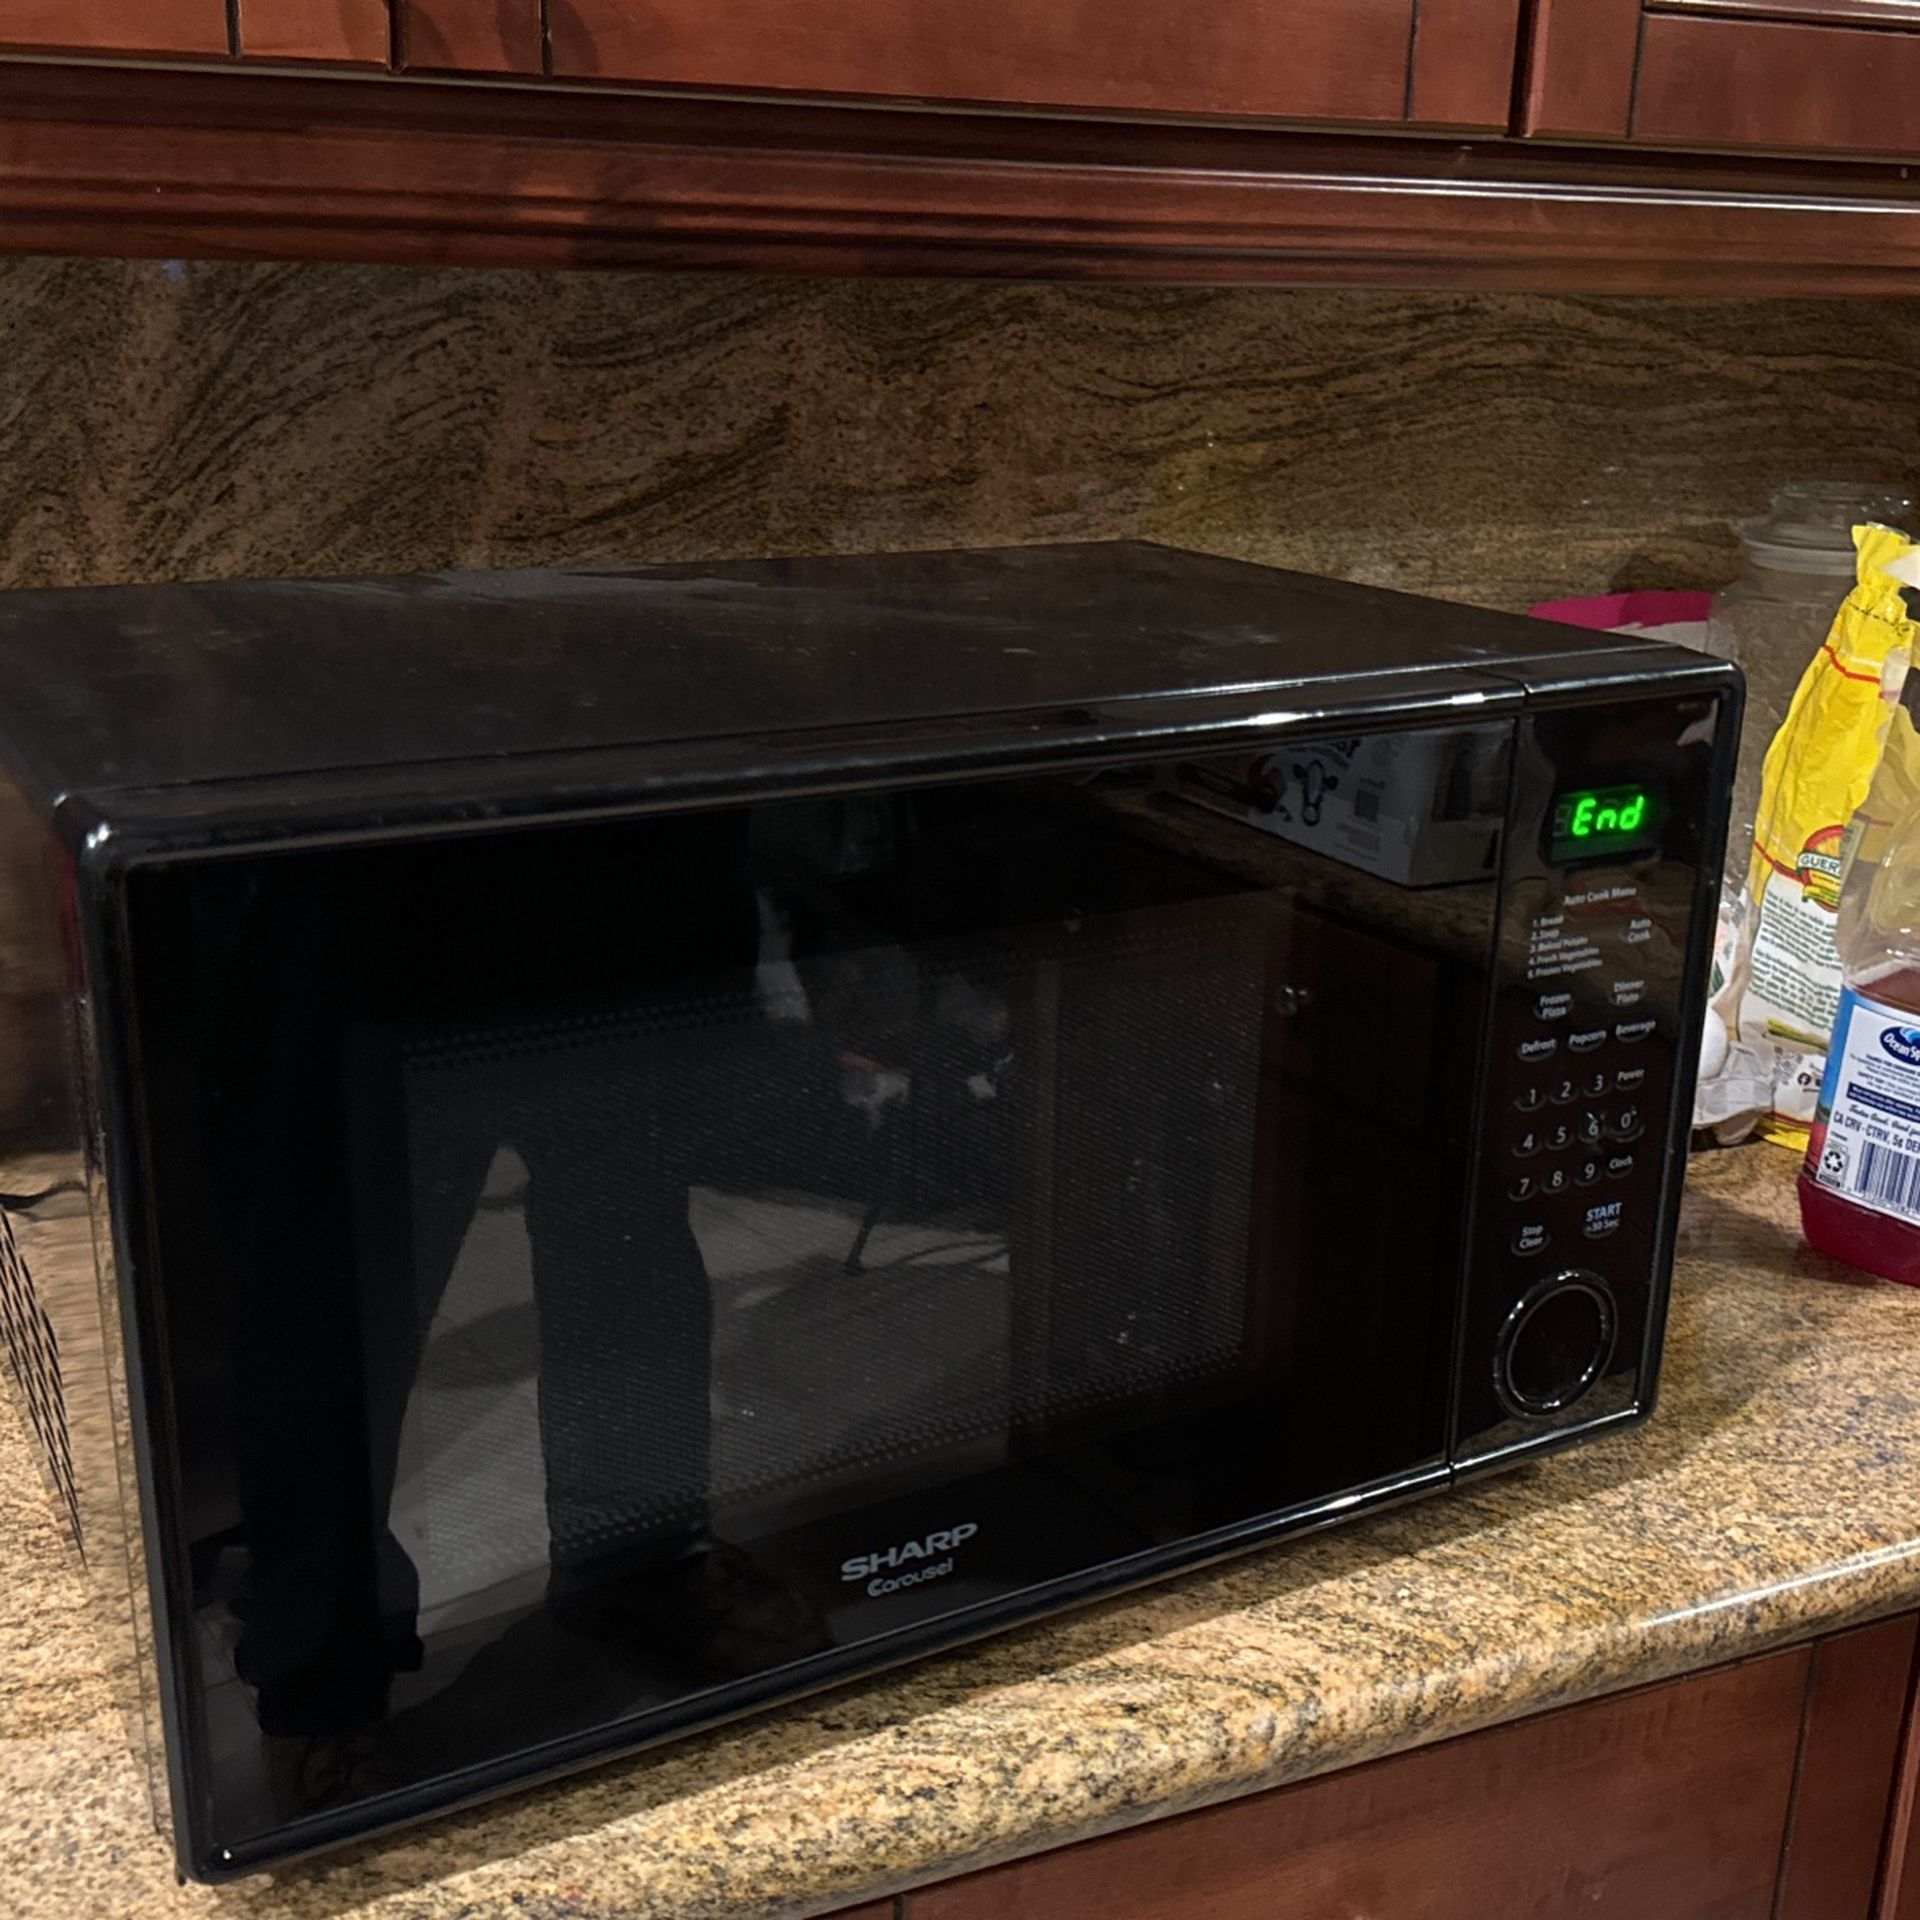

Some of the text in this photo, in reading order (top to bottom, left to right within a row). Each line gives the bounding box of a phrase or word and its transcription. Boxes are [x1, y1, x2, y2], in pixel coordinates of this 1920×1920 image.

[1571, 795, 1645, 836] End
[1800, 854, 1842, 874] GUER
[1587, 889, 1610, 903] Cook
[1611, 887, 1637, 899] Menu
[1628, 930, 1651, 944] Cook
[1521, 1038, 1557, 1054] Defrost
[1569, 1029, 1608, 1045] Popcorn
[1884, 1033, 1910, 1057] Ocean
[1560, 1081, 1572, 1098] 2
[1593, 1074, 1605, 1091] 3
[1522, 1133, 1534, 1149] 4
[1556, 1126, 1567, 1144] 5
[1620, 1112, 1632, 1128] 0
[1833, 1110, 1844, 1125] CA
[1844, 1115, 1861, 1132] CRV
[1904, 1138, 1920, 1154] DE
[1520, 1155, 1633, 1194] 7 8 9 Clock
[1585, 1202, 1622, 1222] START
[840, 1522, 979, 1582] SHARP
[866, 1556, 954, 1598] Carousel
